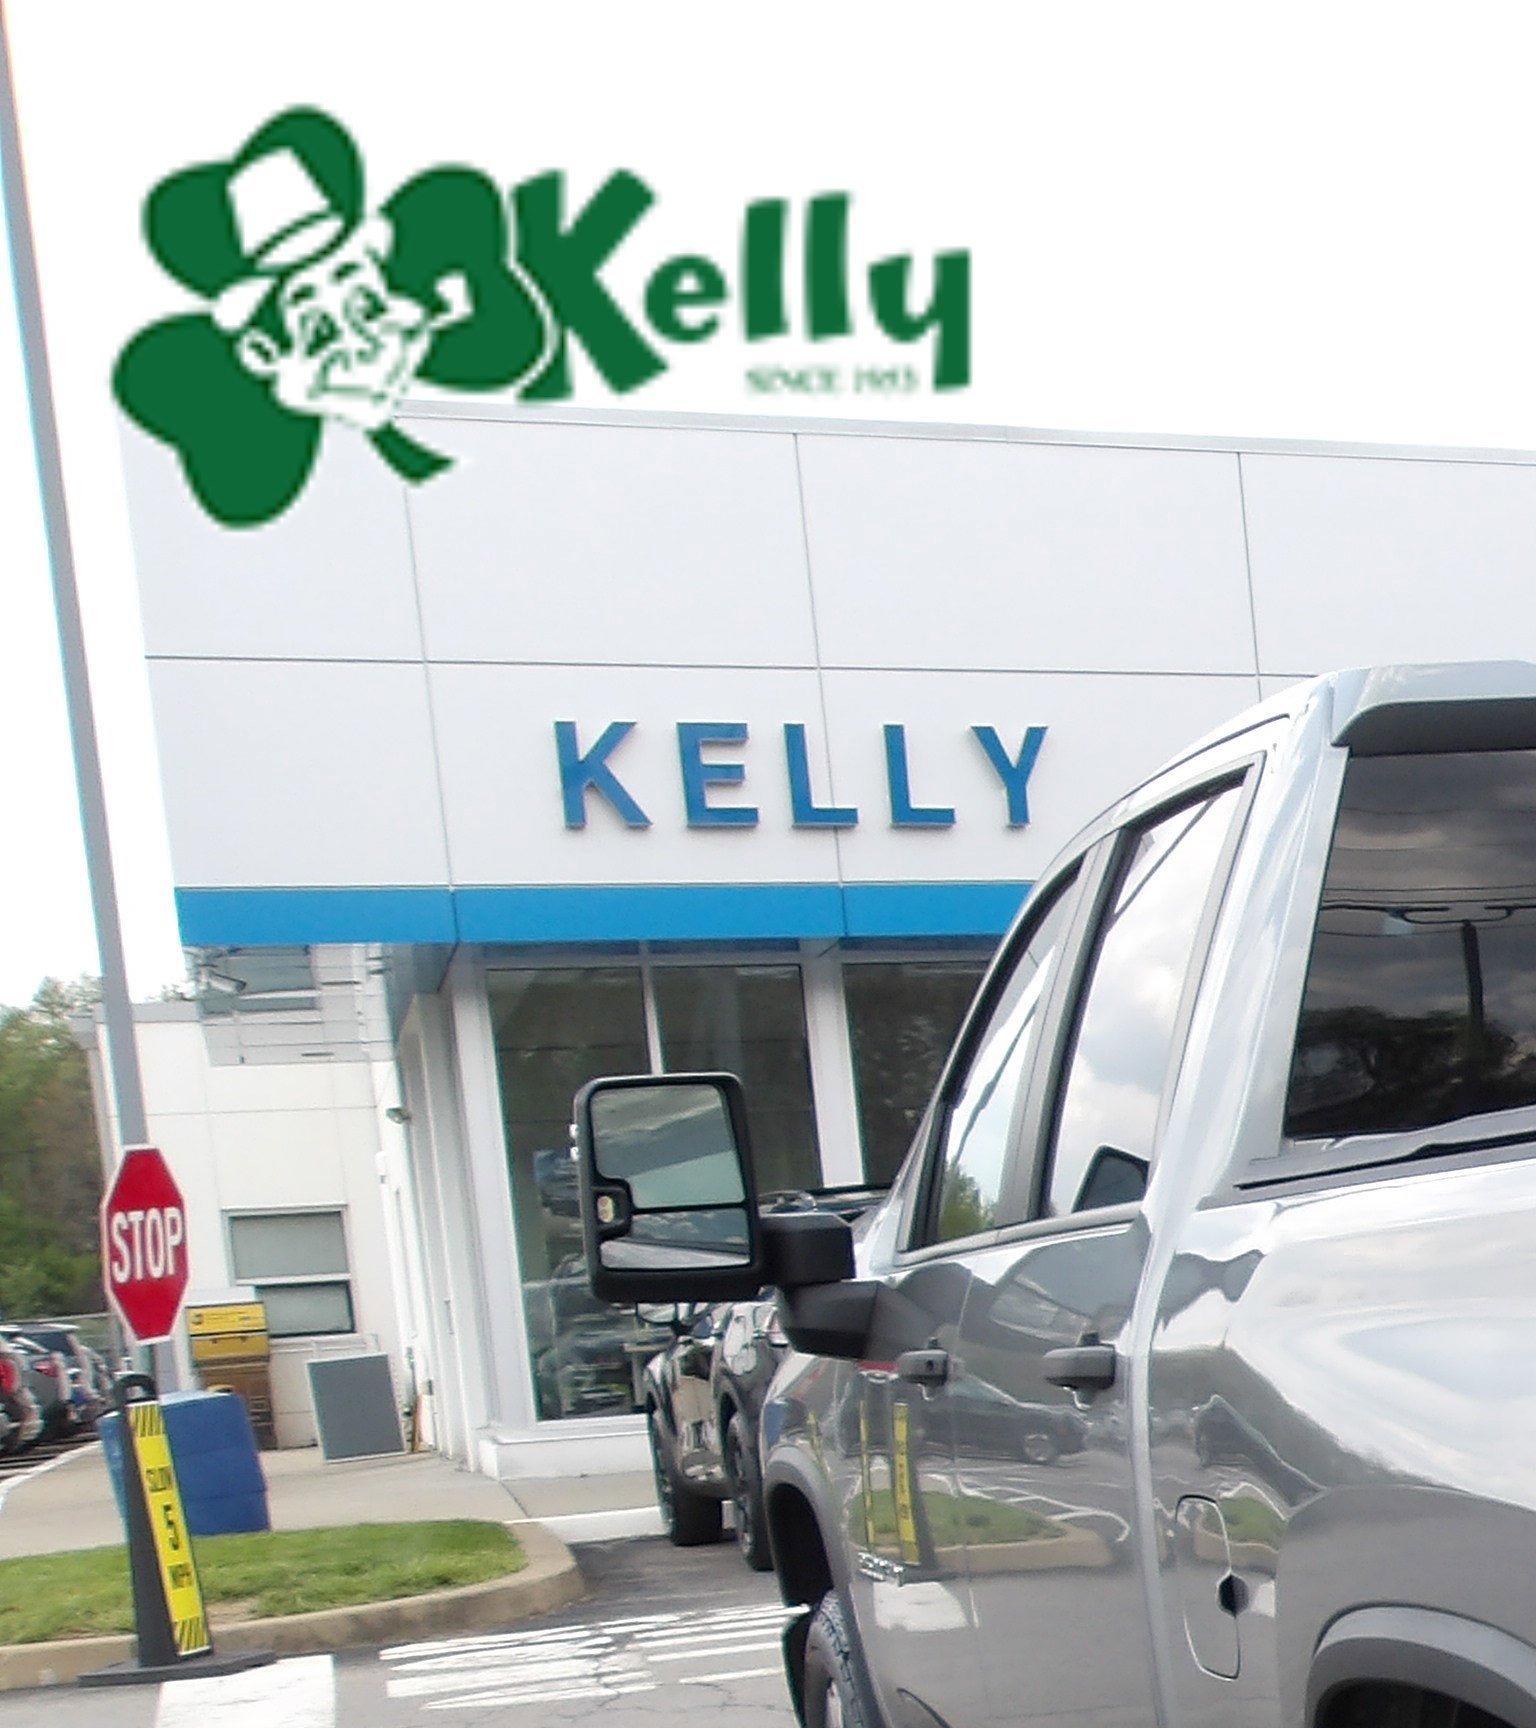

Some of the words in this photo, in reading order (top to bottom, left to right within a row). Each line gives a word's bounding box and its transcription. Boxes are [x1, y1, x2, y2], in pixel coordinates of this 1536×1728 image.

[554, 720, 1047, 830] KELLY
[111, 1207, 183, 1284] STOP
[162, 1503, 181, 1552] 5
